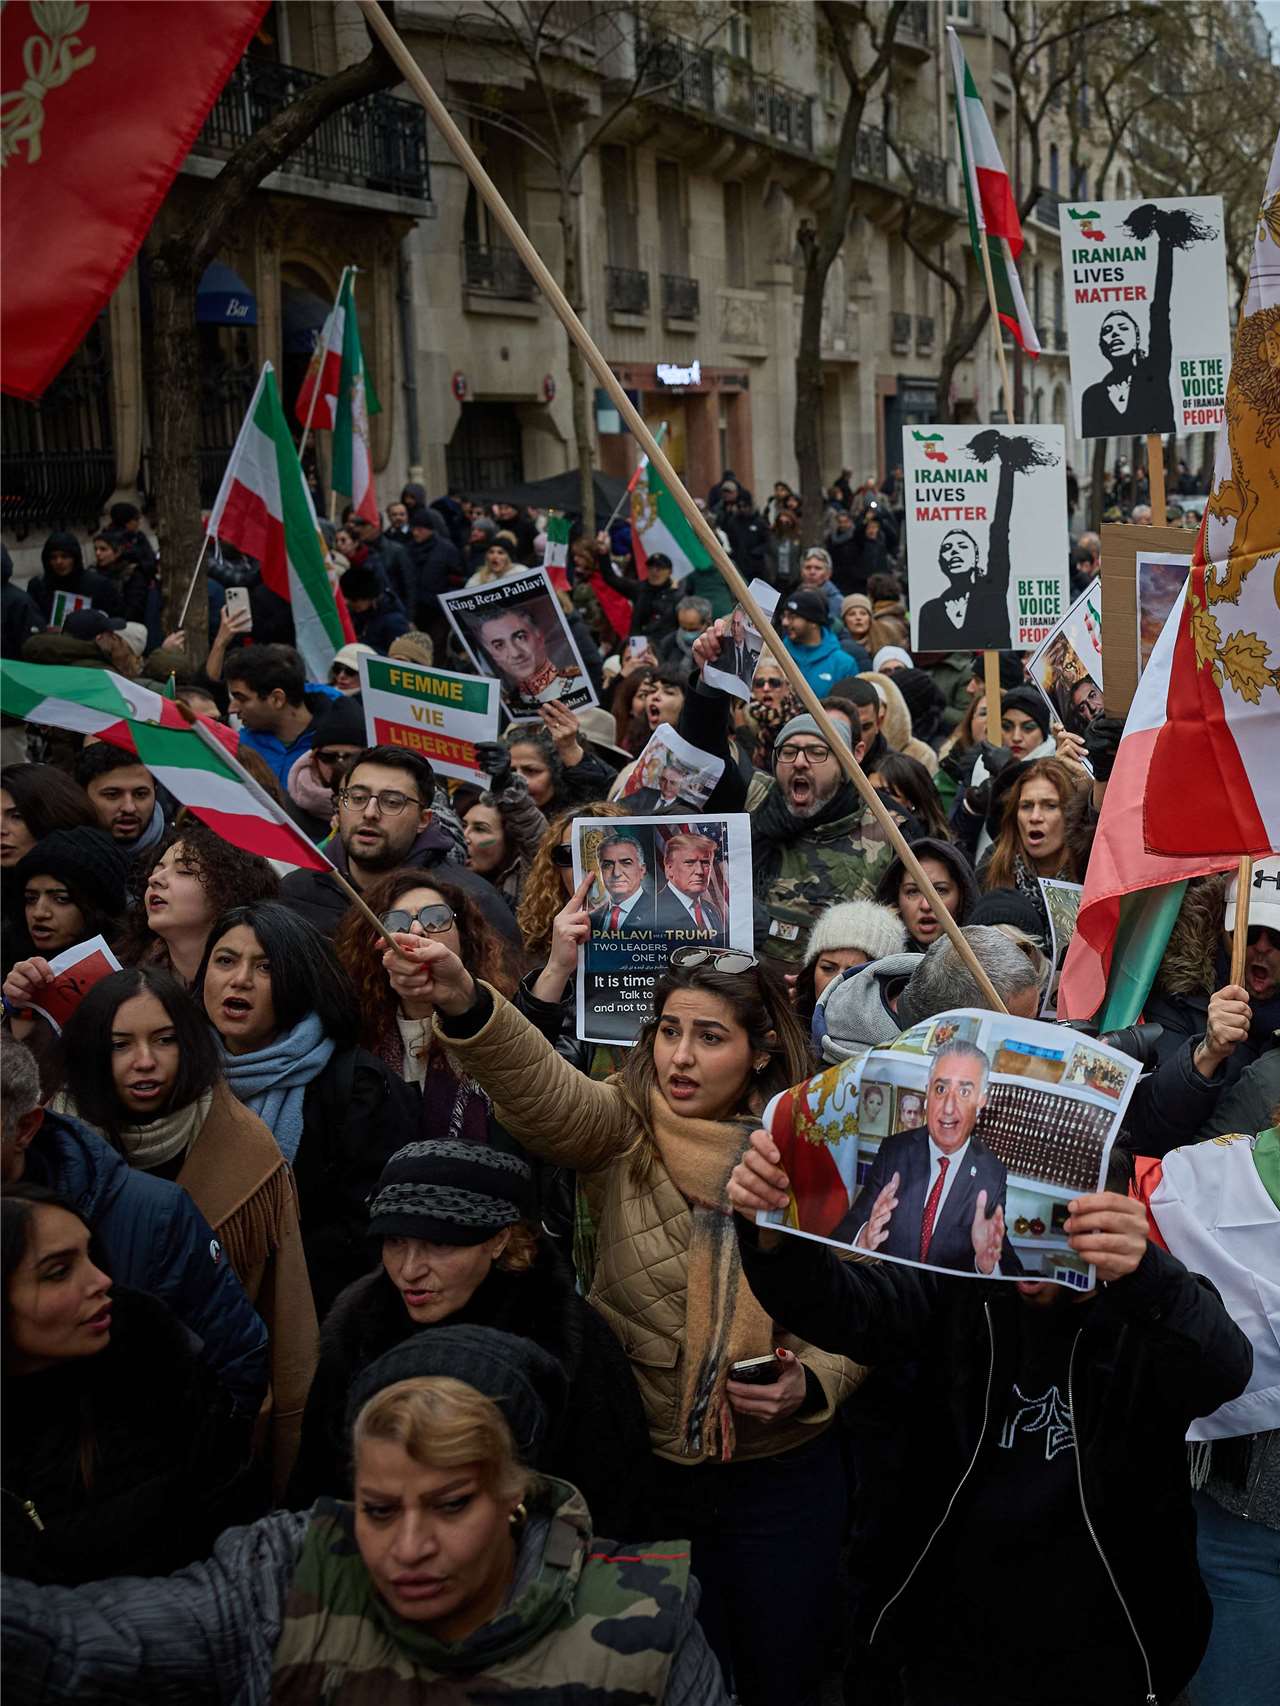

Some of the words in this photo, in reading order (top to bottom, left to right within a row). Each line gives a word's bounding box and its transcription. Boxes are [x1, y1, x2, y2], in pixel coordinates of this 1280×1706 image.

[1072, 246, 1147, 264] IRANIAN
[1073, 267, 1125, 284] LIVES
[1075, 285, 1147, 304] MATTER
[226, 299, 249, 317] Bar
[1180, 360, 1196, 377] BE
[1199, 359, 1223, 376] THE
[1182, 377, 1224, 397] VOICE
[1183, 399, 1192, 409] OF
[1193, 397, 1225, 408] IRANIAN
[915, 469, 988, 483] IRANIAN
[915, 488, 965, 502] LIVES
[916, 506, 987, 522] MATTER
[448, 599, 476, 611] King
[474, 592, 502, 605] Reza
[502, 575, 545, 597] Pahlavi
[1018, 581, 1035, 596] BE
[1038, 580, 1060, 595] THE
[1019, 597, 1061, 615] VOICE
[1019, 617, 1028, 626] OF
[1020, 628, 1051, 643] PEOP
[389, 668, 464, 701] FEMME
[564, 693, 587, 707] ahlavi
[410, 704, 445, 727] VIE
[592, 930, 652, 940] PAHLAVI
[665, 929, 718, 940] TRUMP
[593, 943, 618, 951] TWO
[620, 943, 668, 951] LEADERS
[631, 953, 656, 962] ONE
[594, 975, 604, 988] It
[608, 975, 619, 988] is
[623, 975, 655, 987] time
[620, 991, 640, 1000] Talk
[642, 991, 654, 1000] to
[594, 1003, 614, 1013] and
[617, 1003, 634, 1012] not
[636, 1003, 647, 1011] to
